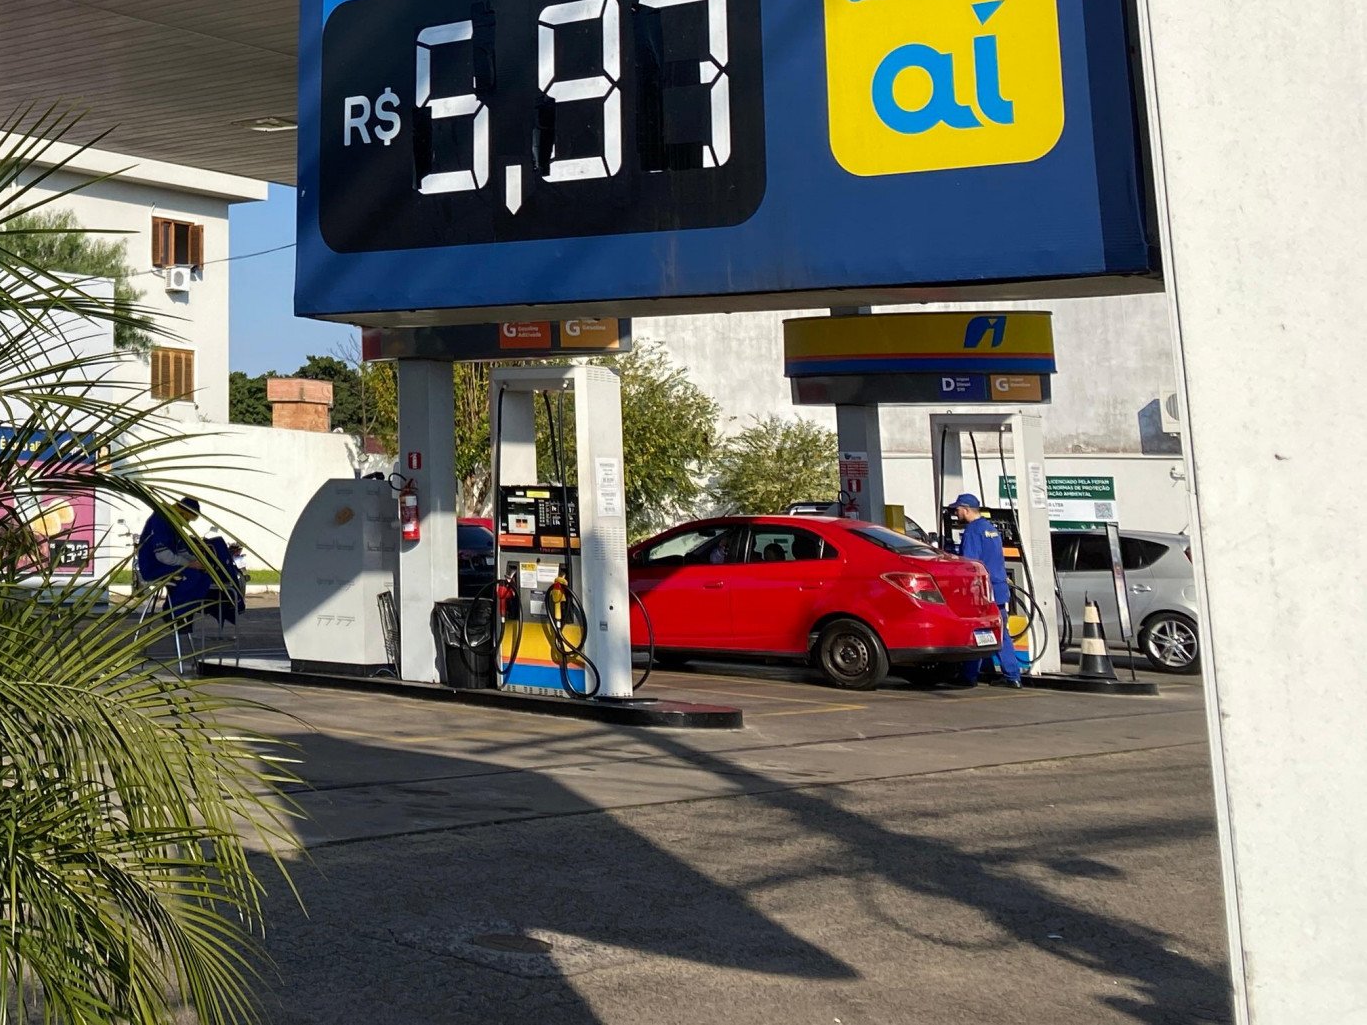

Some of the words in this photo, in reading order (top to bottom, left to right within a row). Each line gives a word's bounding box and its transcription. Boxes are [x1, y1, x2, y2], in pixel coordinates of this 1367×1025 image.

[343, 87, 402, 147] R$
[942, 378, 955, 391] D
[995, 378, 1009, 392] G
